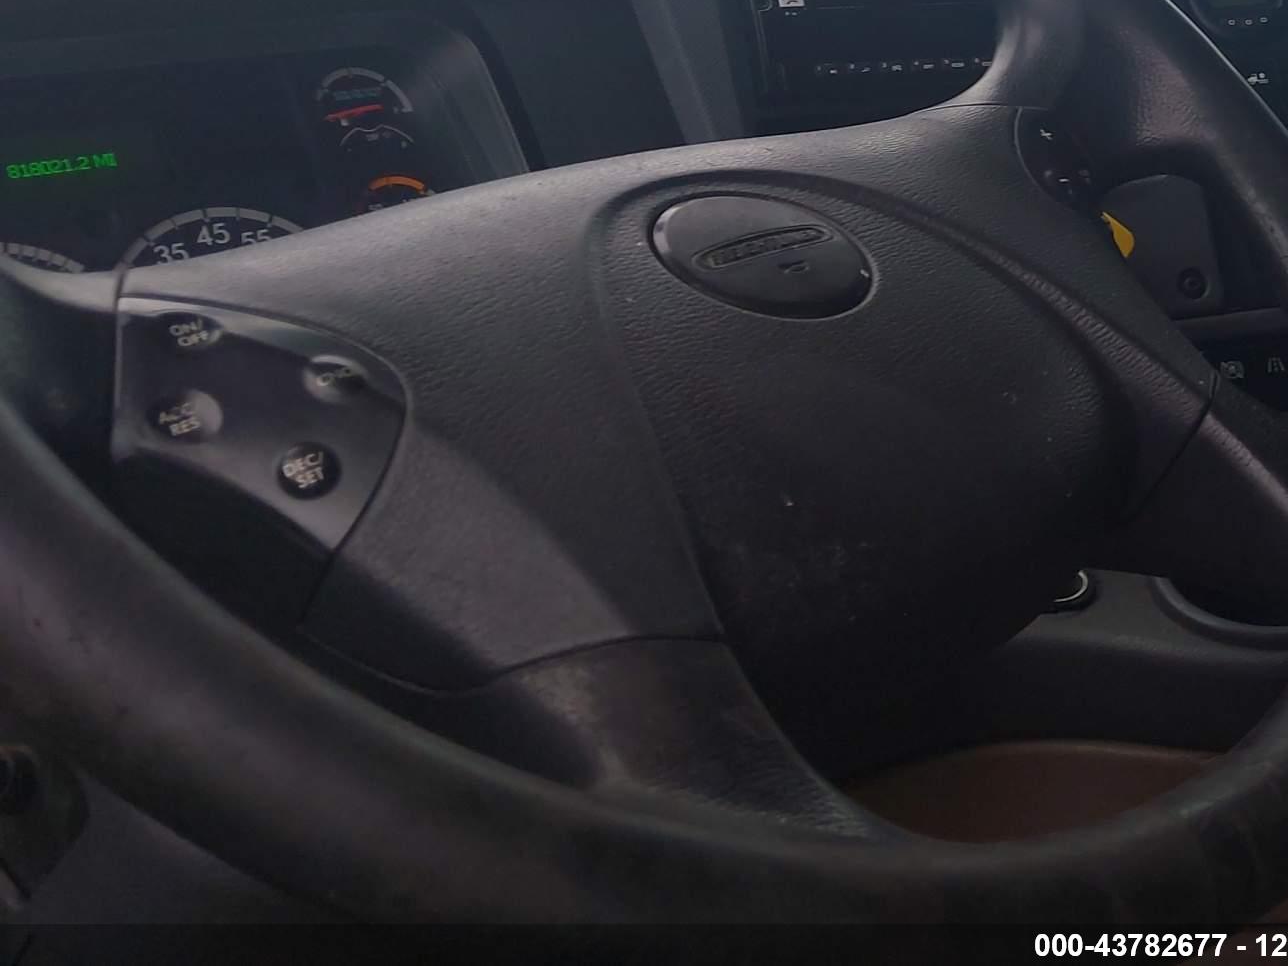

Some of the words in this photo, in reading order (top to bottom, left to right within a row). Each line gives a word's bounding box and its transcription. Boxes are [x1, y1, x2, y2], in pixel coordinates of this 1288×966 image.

[6, 155, 91, 180] 818021.2
[92, 151, 118, 170] MI
[196, 221, 232, 247] 45
[153, 242, 190, 264] 35
[177, 330, 210, 347] OFF
[169, 419, 202, 437] RES
[296, 467, 325, 489] SET
